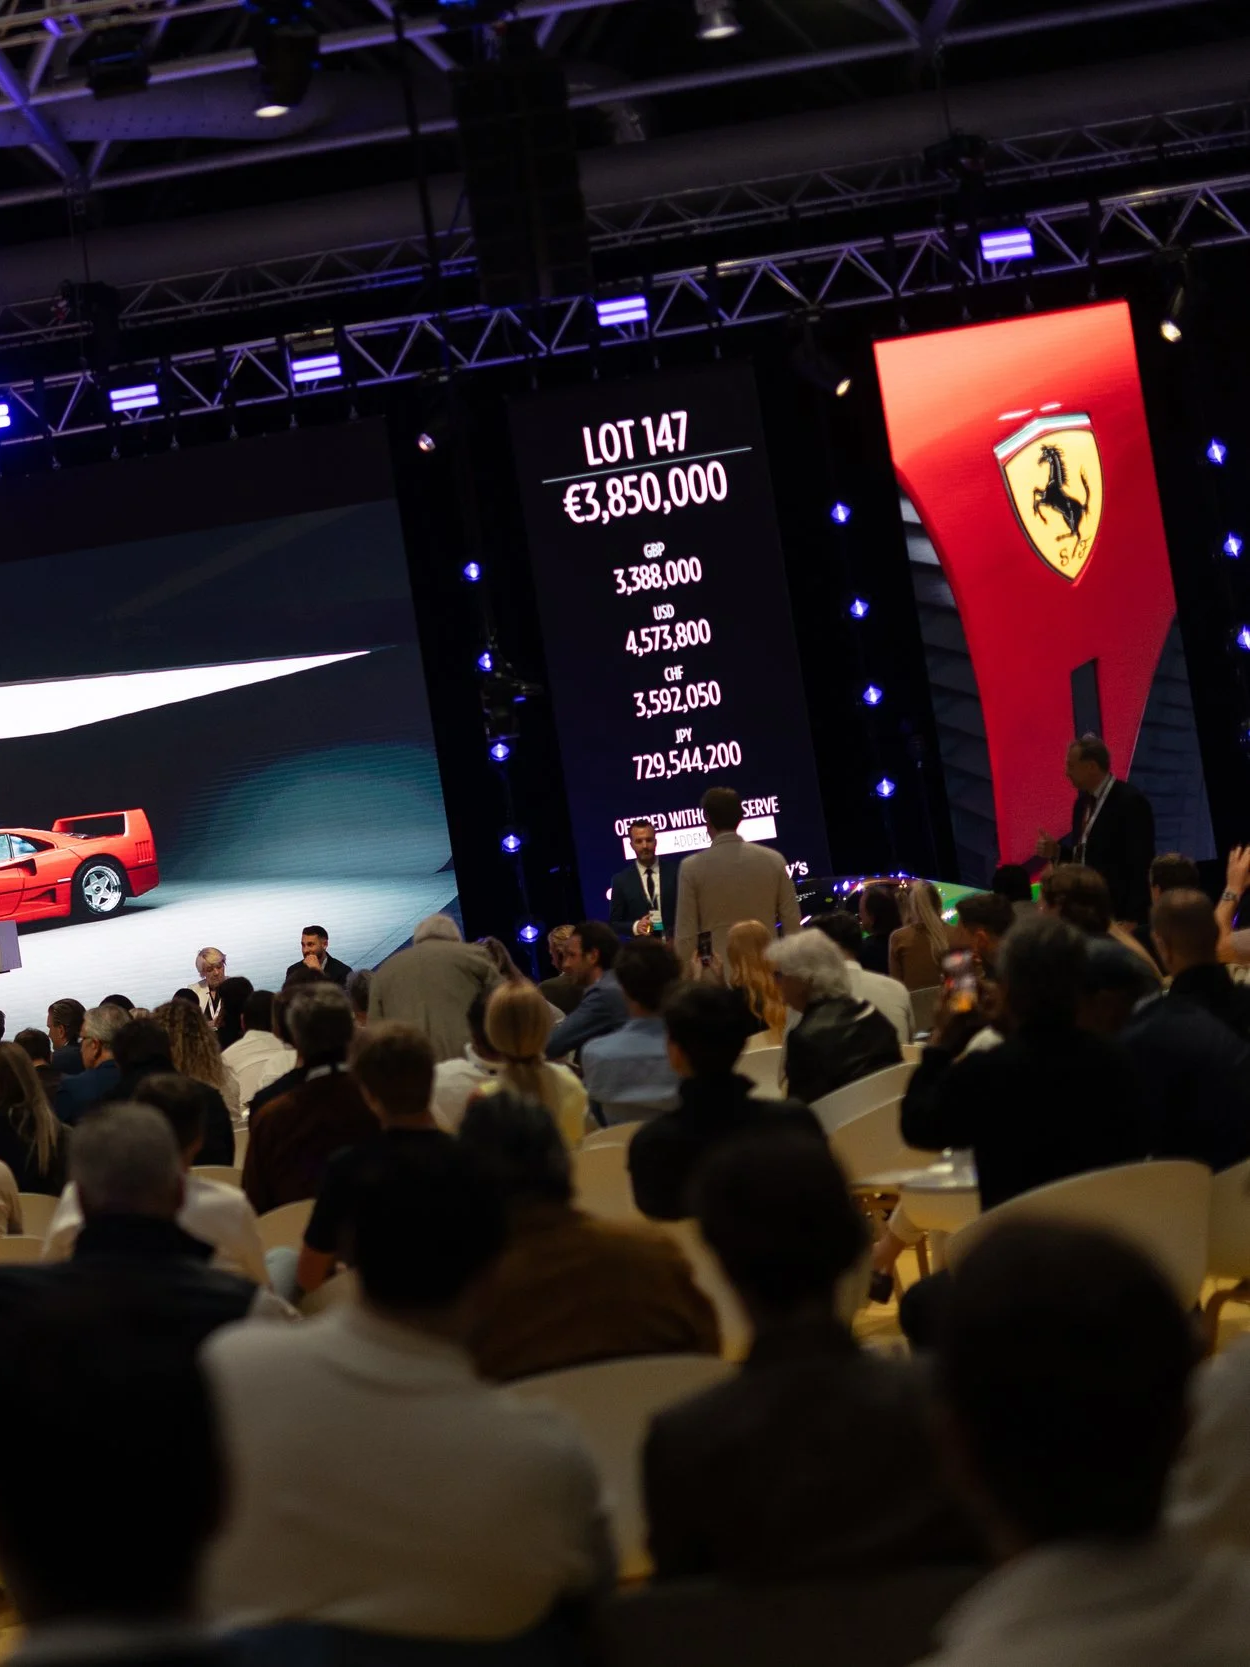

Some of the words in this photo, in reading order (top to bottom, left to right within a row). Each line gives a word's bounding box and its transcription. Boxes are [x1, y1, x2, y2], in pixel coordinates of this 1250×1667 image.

[582, 419, 634, 466] LOT
[641, 410, 688, 454] 147
[563, 460, 728, 524] €3,850,000
[643, 542, 665, 558] GBP
[613, 556, 702, 595] 3,388,000
[653, 604, 675, 620] USD
[625, 618, 711, 657] 4,573,800
[664, 666, 684, 682] CHF
[633, 681, 721, 719] 3,592,050
[675, 728, 692, 743] JPY
[632, 741, 742, 781] 729,544,200
[741, 796, 780, 817] SERVE
